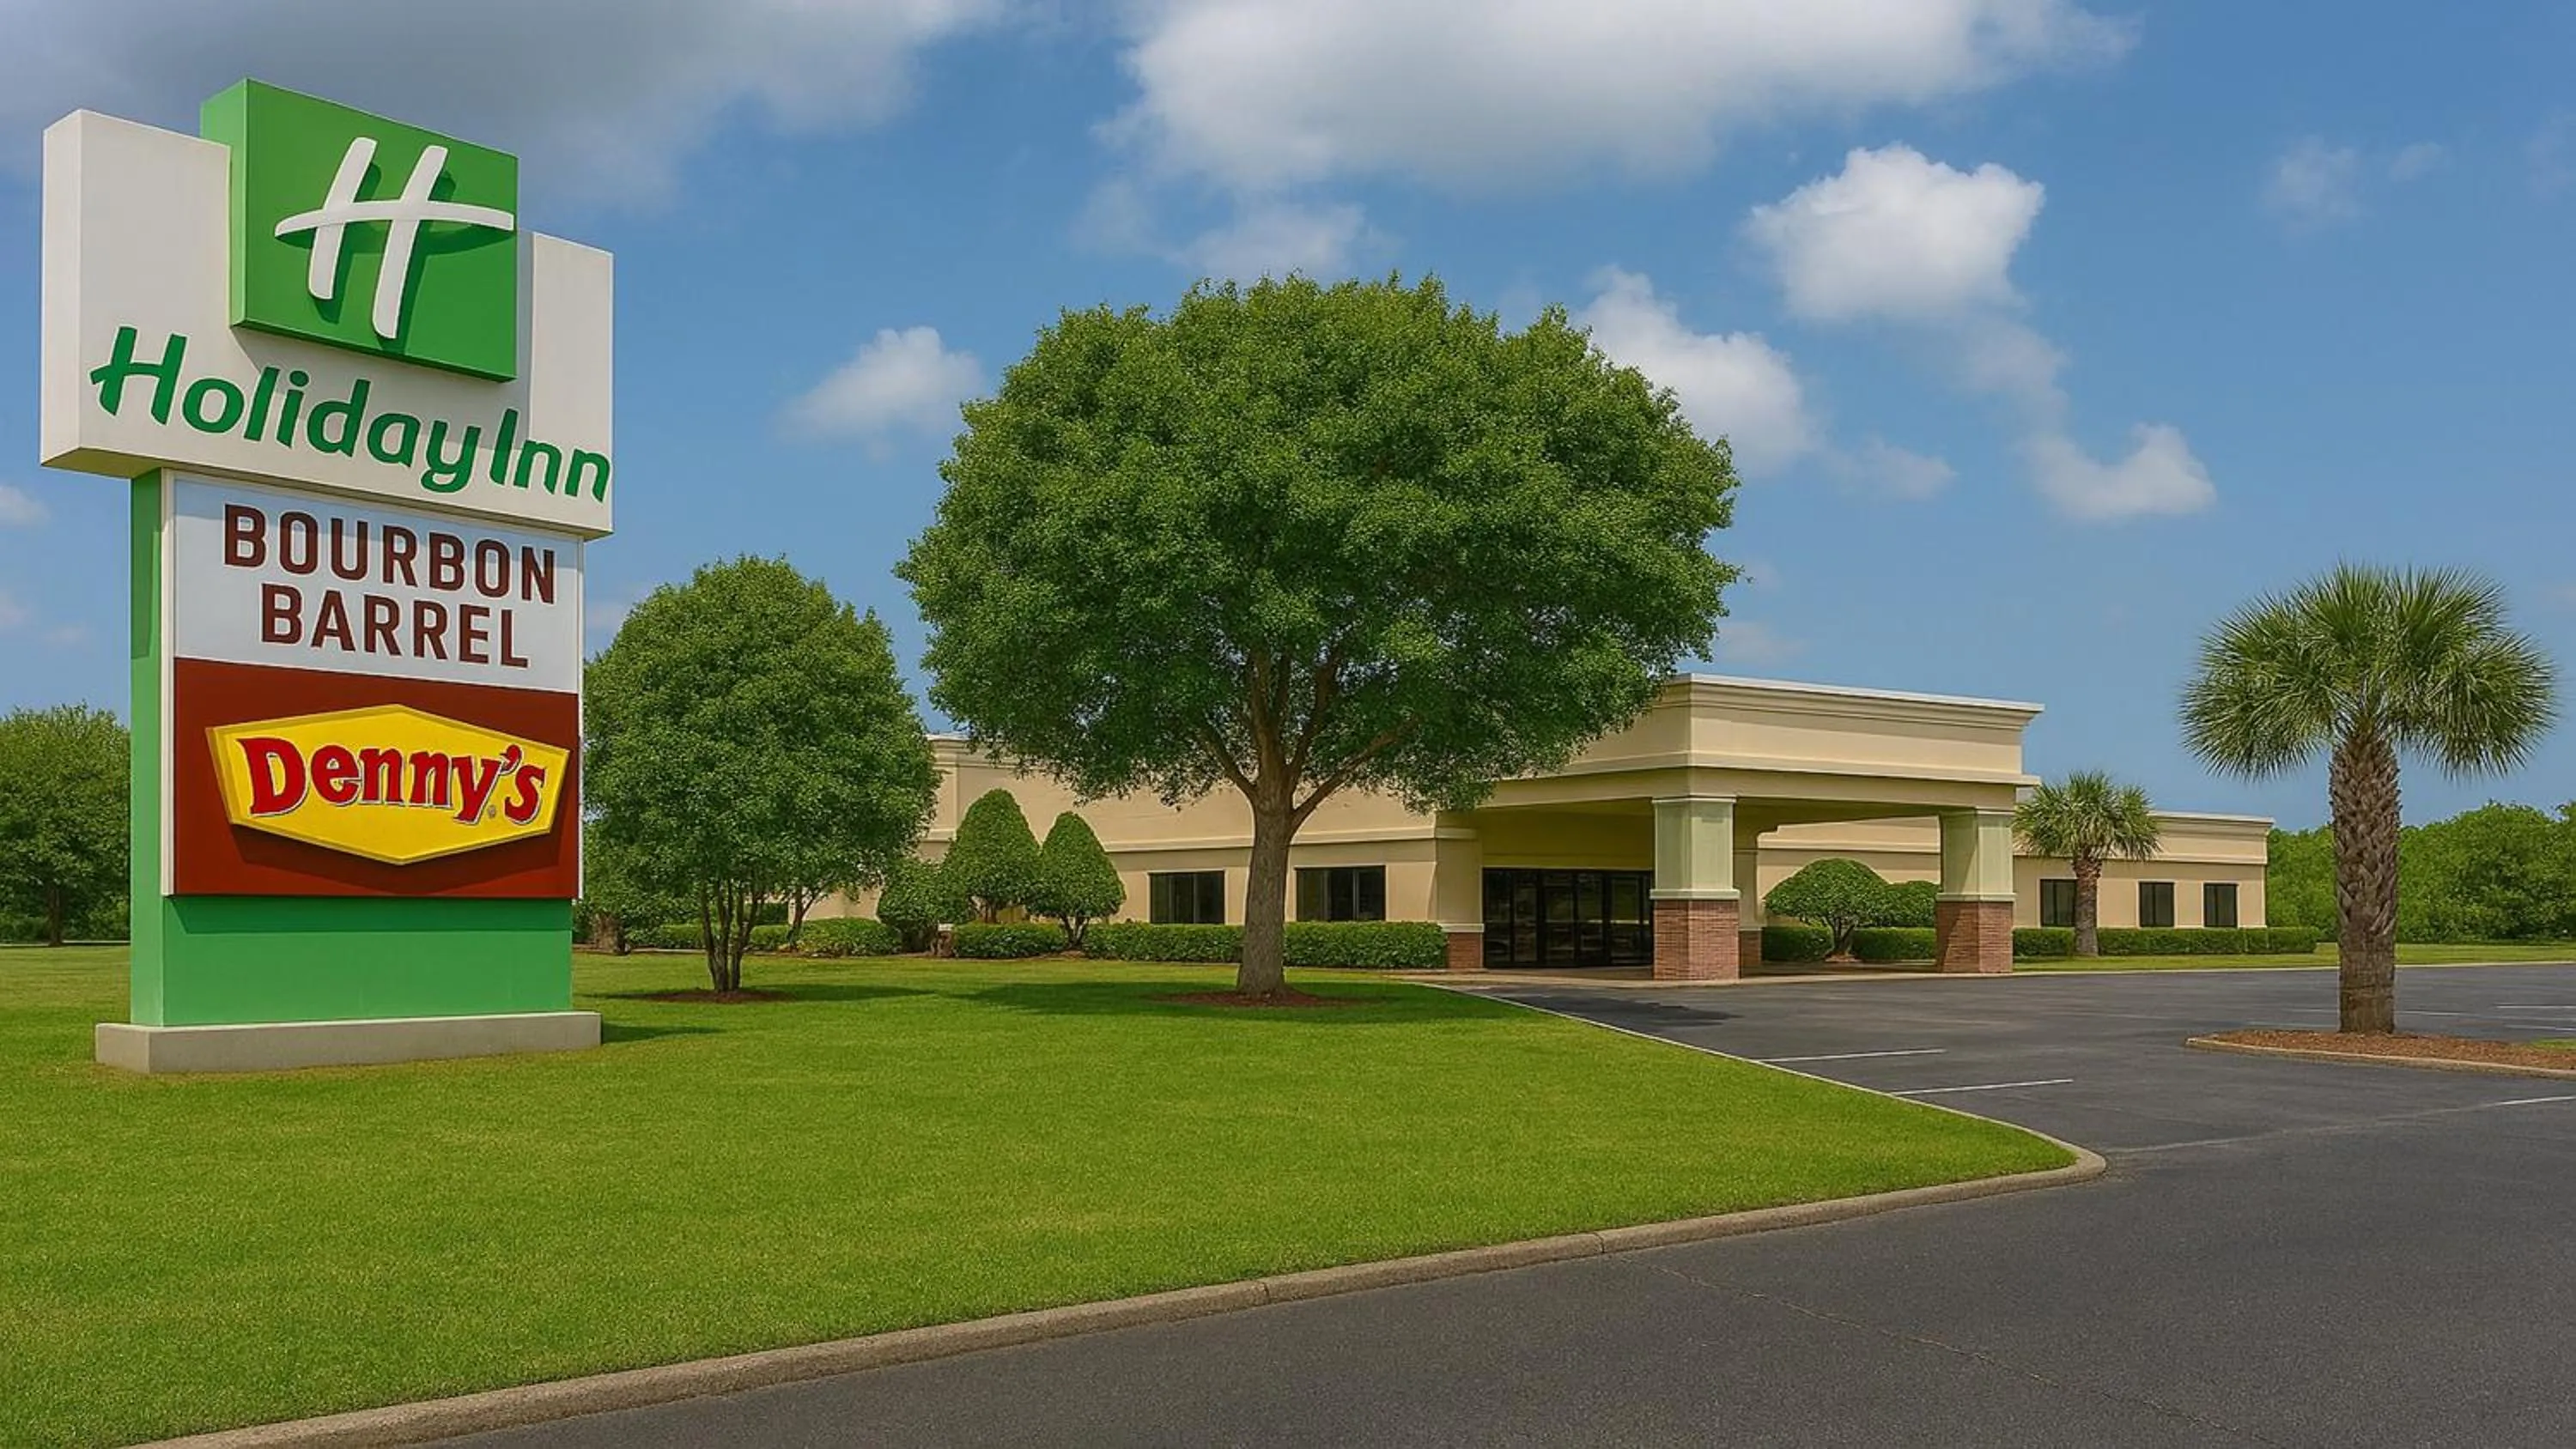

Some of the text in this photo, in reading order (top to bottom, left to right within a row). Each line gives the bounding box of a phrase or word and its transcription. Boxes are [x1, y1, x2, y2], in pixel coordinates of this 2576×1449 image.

[90, 325, 611, 503] Holiday Inn
[224, 504, 555, 603] BOURBON
[262, 584, 528, 667] BARREL
[237, 737, 545, 824] Denny's
